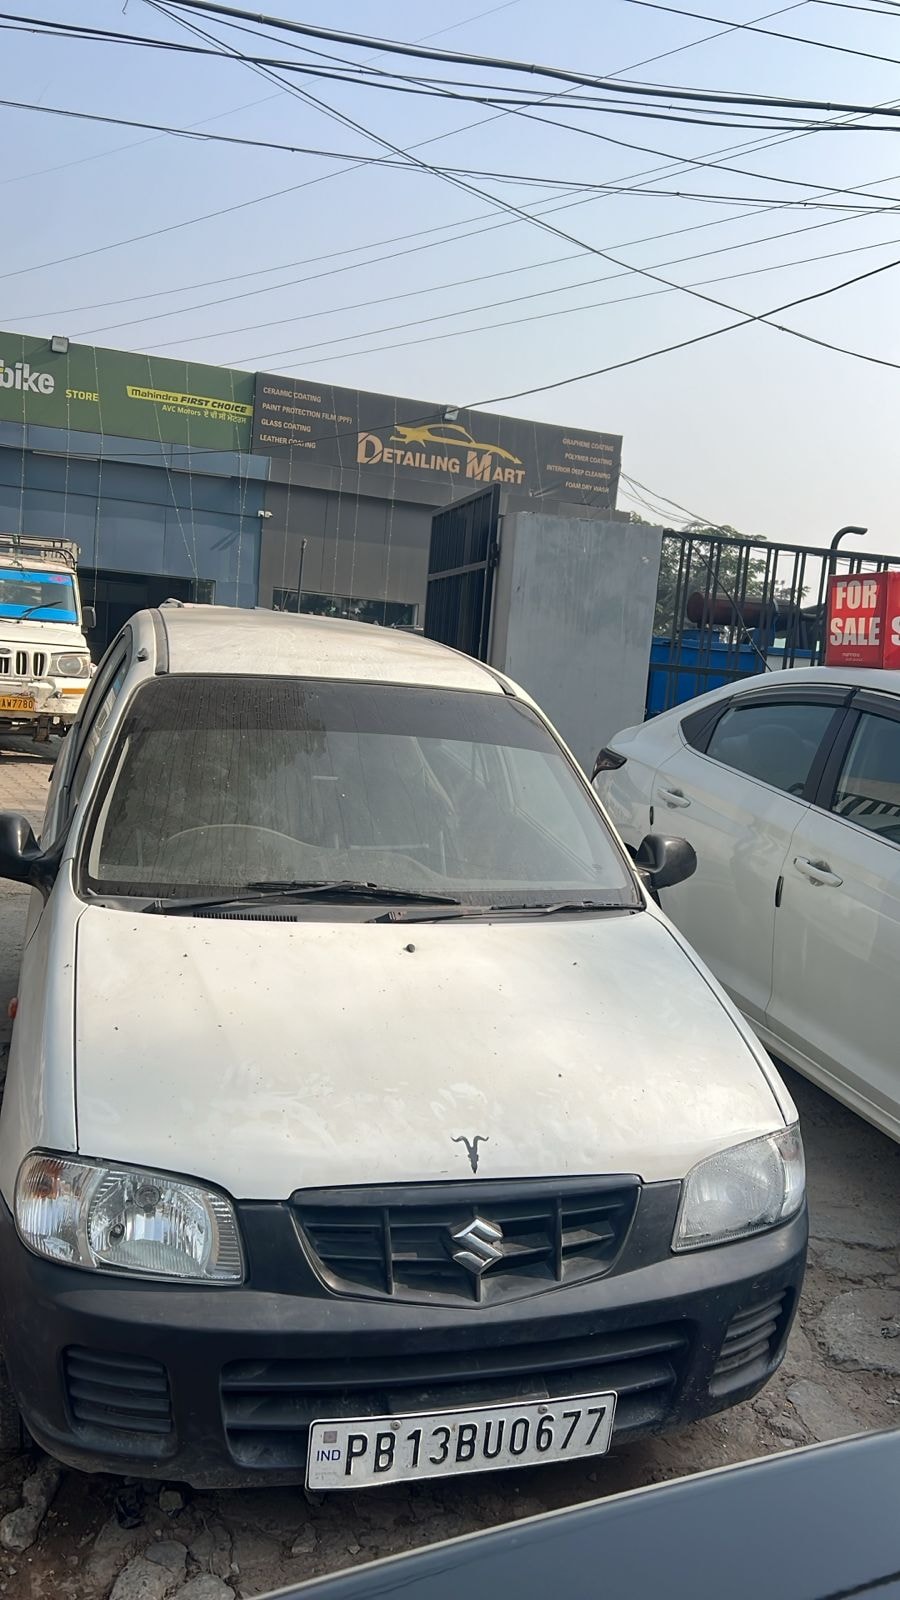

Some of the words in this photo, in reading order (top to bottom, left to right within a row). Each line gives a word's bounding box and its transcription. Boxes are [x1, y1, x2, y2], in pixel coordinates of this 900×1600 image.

[65, 389, 99, 402] STORE
[263, 387, 292, 398] CERAMIC
[293, 392, 321, 403] COATING
[161, 404, 176, 413] AVC
[177, 407, 201, 417] Motors
[180, 395, 211, 407] FIRST
[211, 401, 248, 413] CHOICE
[262, 402, 281, 412] PAINT
[282, 406, 320, 418] PROTECTION
[321, 412, 336, 421] FILM
[261, 418, 282, 428] GLASS
[283, 422, 312, 433] COATING
[260, 434, 290, 444] LEATHER
[591, 443, 614, 452] COATING
[357, 432, 460, 474] DETAILING
[465, 450, 526, 484] MART
[564, 452, 589, 463] POLYMER
[589, 456, 613, 466] COATING
[546, 464, 571, 474] INTERIOR
[571, 467, 585, 476] DEEP
[585, 470, 611, 480] CLEANING
[835, 580, 878, 610] FOR
[829, 617, 881, 646] SALE
[316, 1449, 341, 1462] IND
[344, 1406, 608, 1476] PB13BU0677
